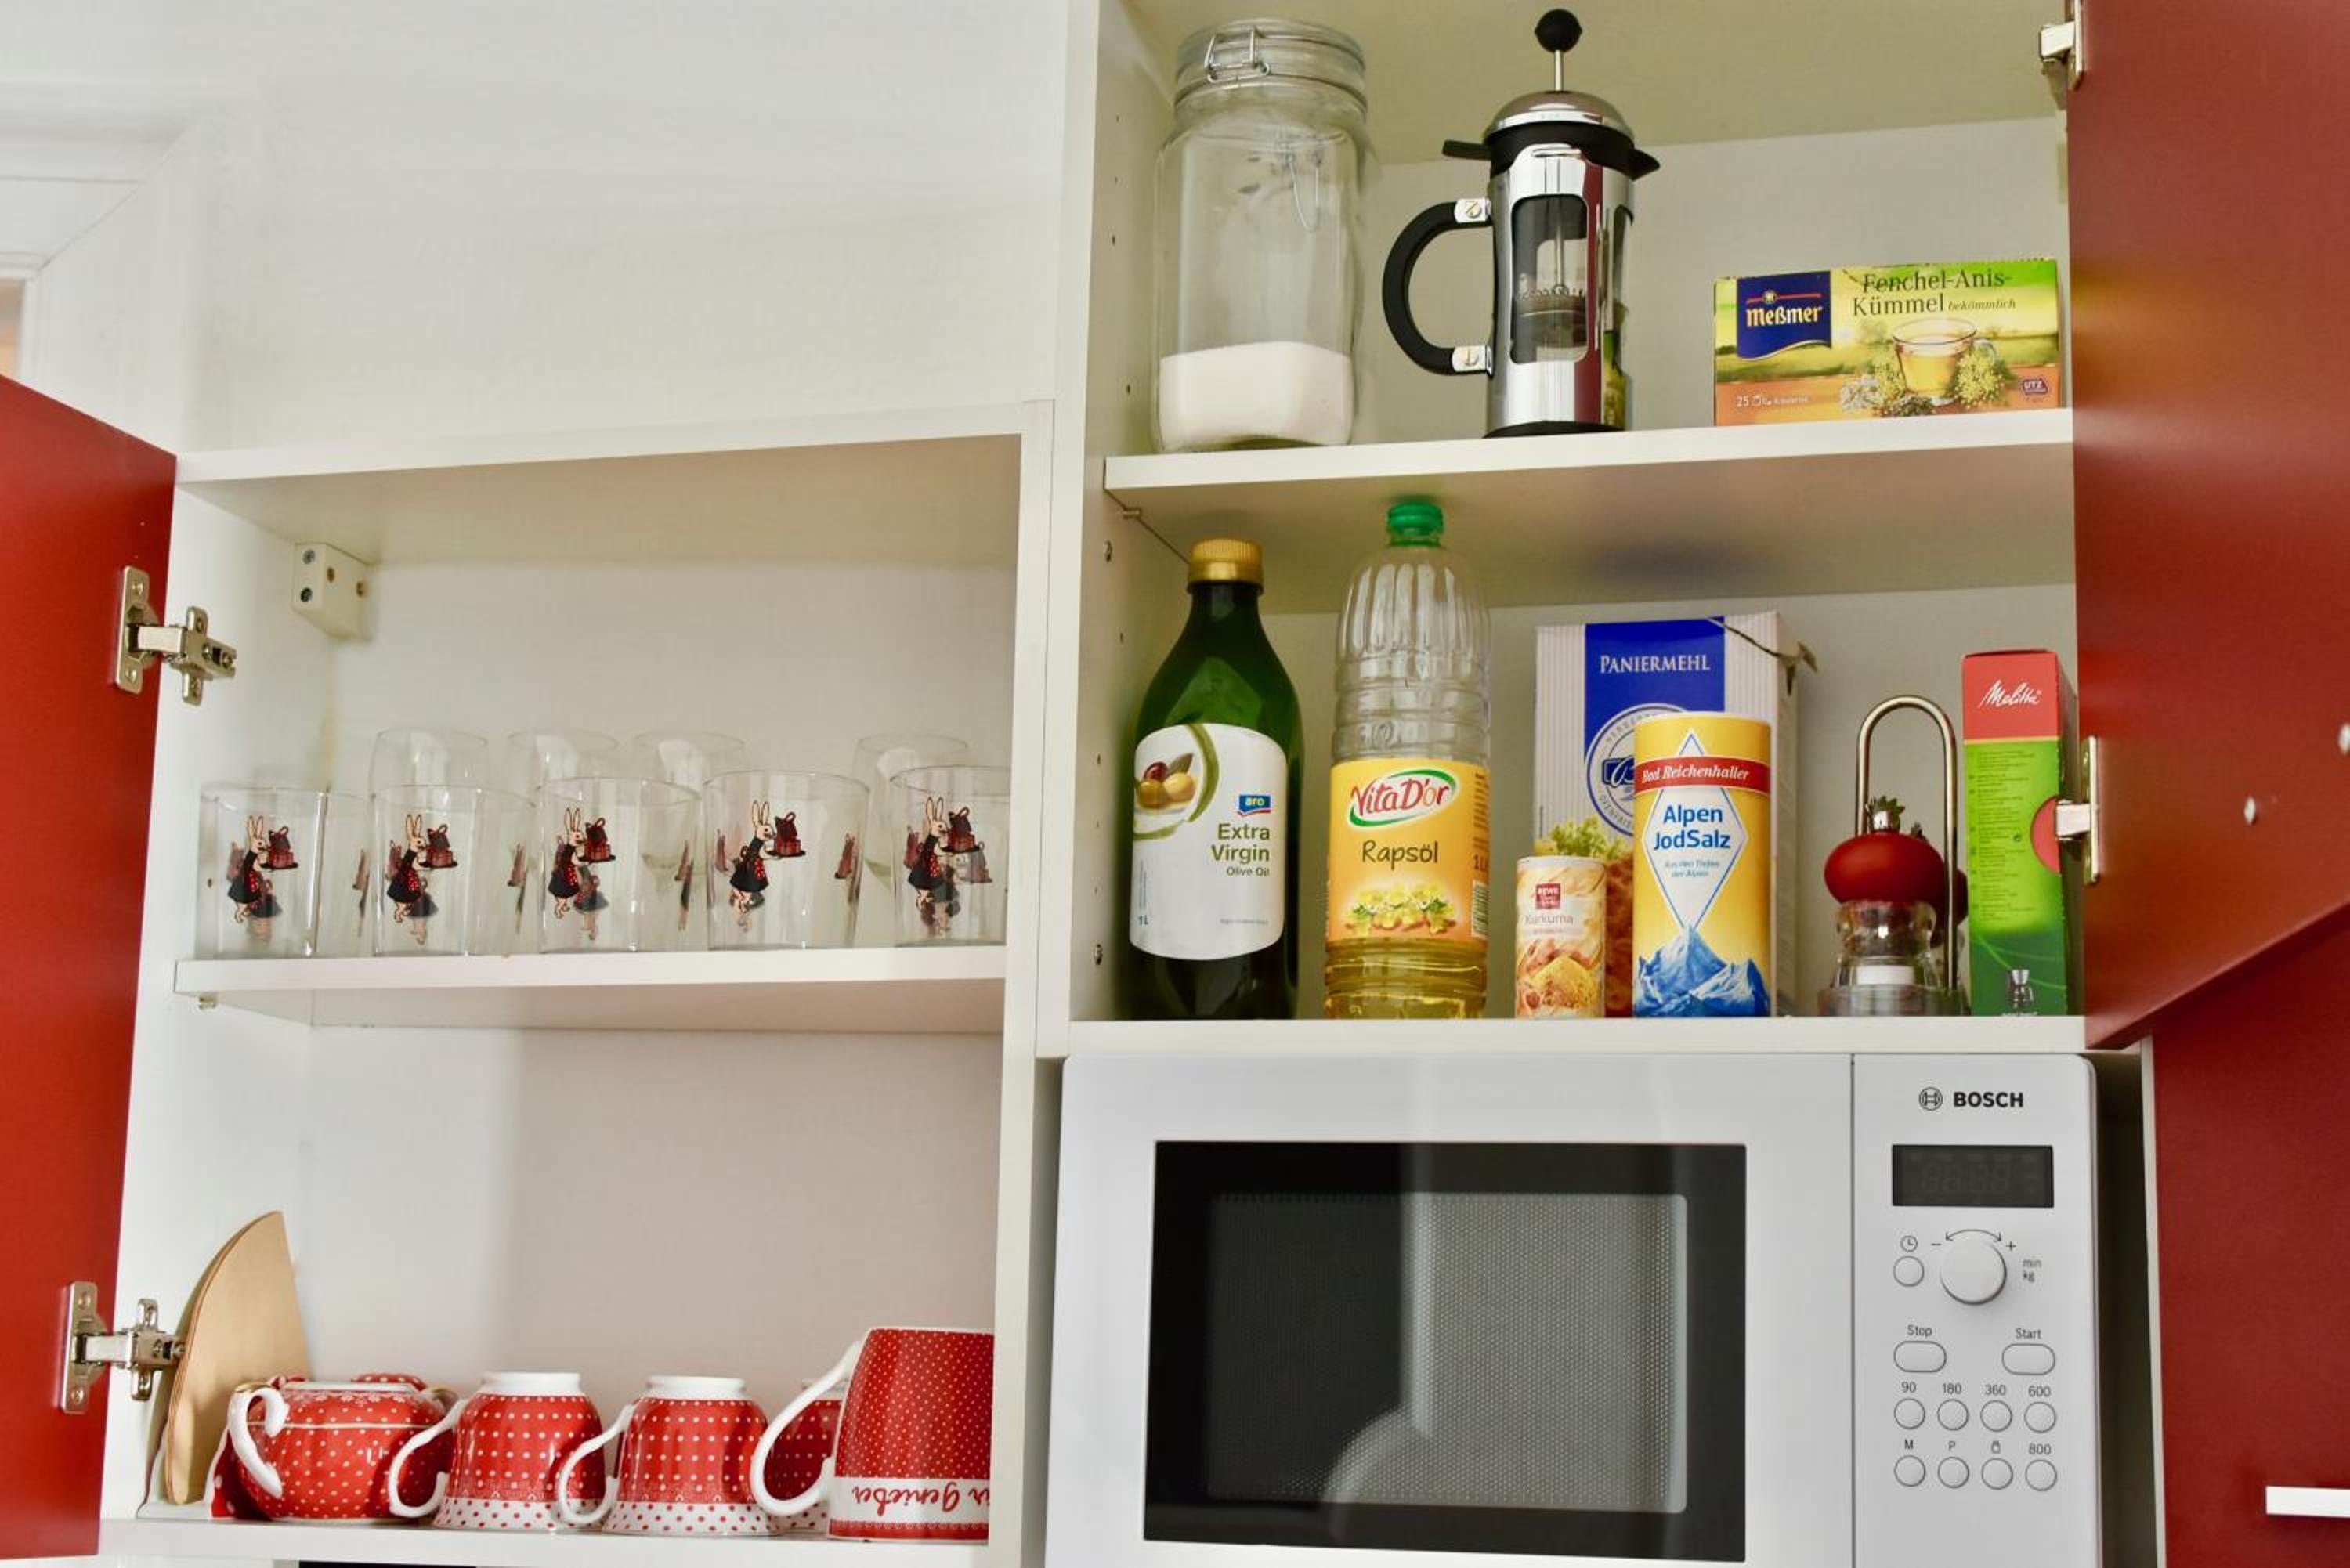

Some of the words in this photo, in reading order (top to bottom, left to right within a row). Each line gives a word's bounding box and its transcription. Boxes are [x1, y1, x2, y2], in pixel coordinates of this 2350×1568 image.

[1863, 267, 2012, 294] Fenchel-Anis-
[1853, 293, 1943, 317] Kümmel
[1947, 298, 2016, 313] bekömmlich
[1745, 305, 1823, 327] Meßmer
[2023, 380, 2044, 389] UTZ
[1600, 654, 1712, 674] PANIERMEHL
[1977, 678, 2039, 709] Melitta
[1662, 764, 1749, 781] Reichenhaller
[1245, 796, 1266, 807] aro
[1663, 804, 1723, 828] Alpen
[1217, 823, 1271, 840] Extra
[1654, 829, 1731, 851] JodSalz
[1211, 844, 1271, 865] Virgin
[1361, 839, 1439, 871] Rapsöl
[1226, 866, 1253, 876] Olive
[1255, 866, 1271, 876] Oil
[1524, 914, 1574, 925] Kurkuma
[1952, 1091, 2024, 1109] BOSCH
[2022, 1258, 2043, 1268] min
[2023, 1270, 2036, 1283] kg
[1907, 1324, 1933, 1339] Stop
[2015, 1327, 2042, 1340] Start
[1901, 1380, 1918, 1393] 90
[1942, 1382, 1963, 1396] 180
[1984, 1384, 2007, 1396] 360
[2027, 1385, 2052, 1398] 600
[1904, 1438, 1914, 1451] M
[1947, 1440, 1957, 1452] P
[2027, 1443, 2052, 1456] 800
